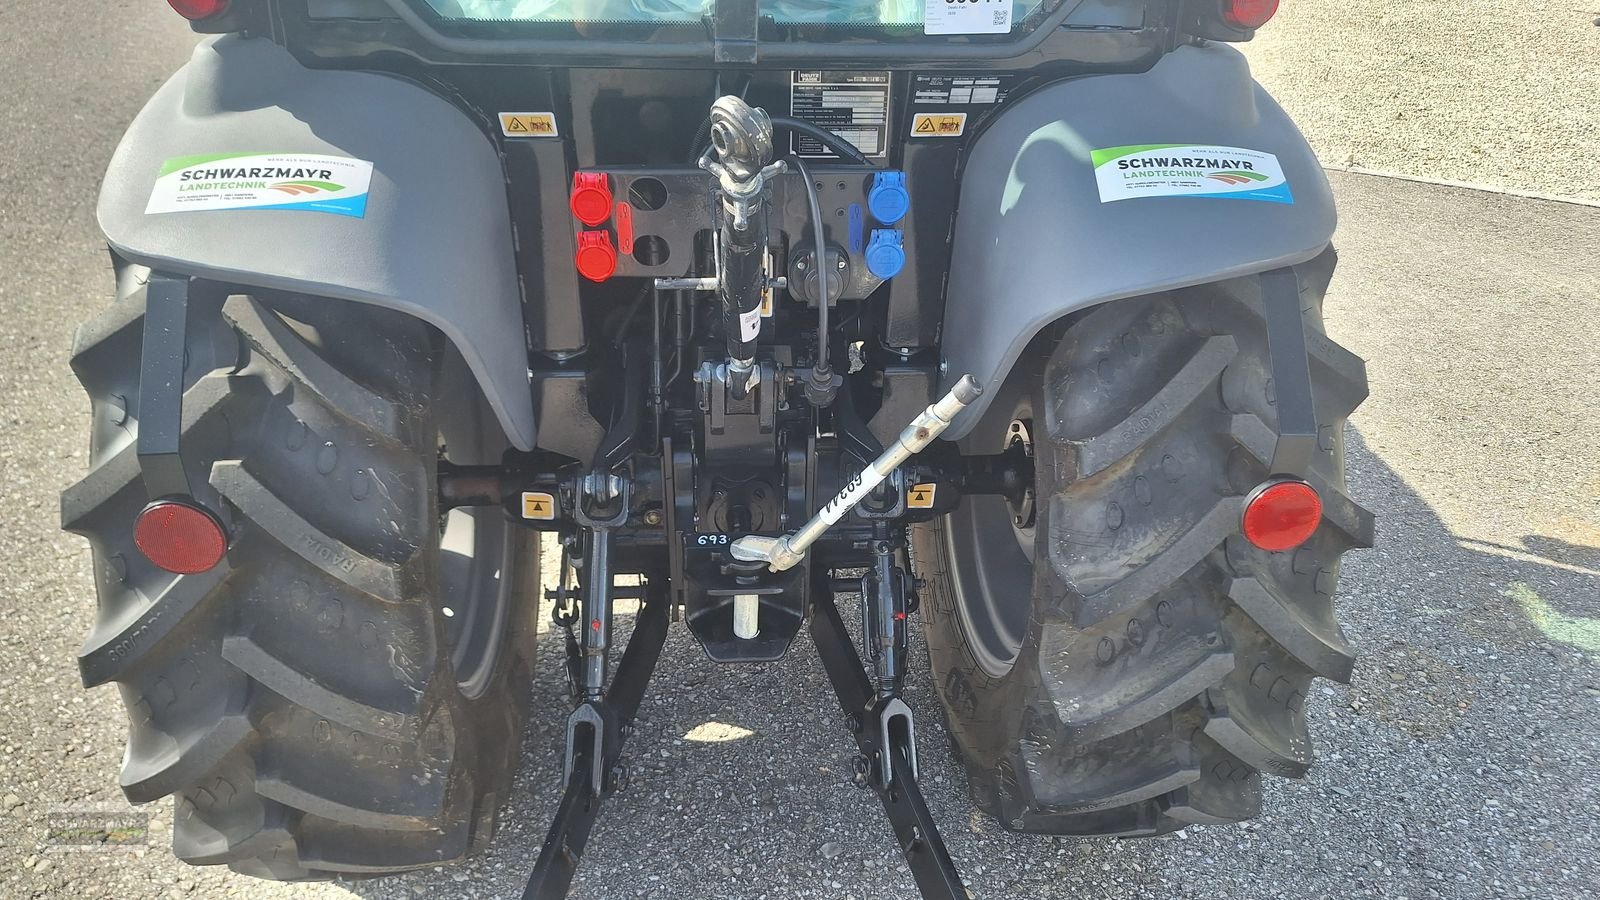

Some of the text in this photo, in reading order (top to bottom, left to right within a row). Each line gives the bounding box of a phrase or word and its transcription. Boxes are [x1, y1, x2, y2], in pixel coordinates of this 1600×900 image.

[1117, 157, 1254, 170] SCHWARZMAYR
[180, 167, 332, 182] SCHWARZMAYR
[1123, 170, 1205, 179] LANDTECHNIK
[179, 181, 267, 192] LANDTECHNIK
[697, 534, 731, 545] 693
